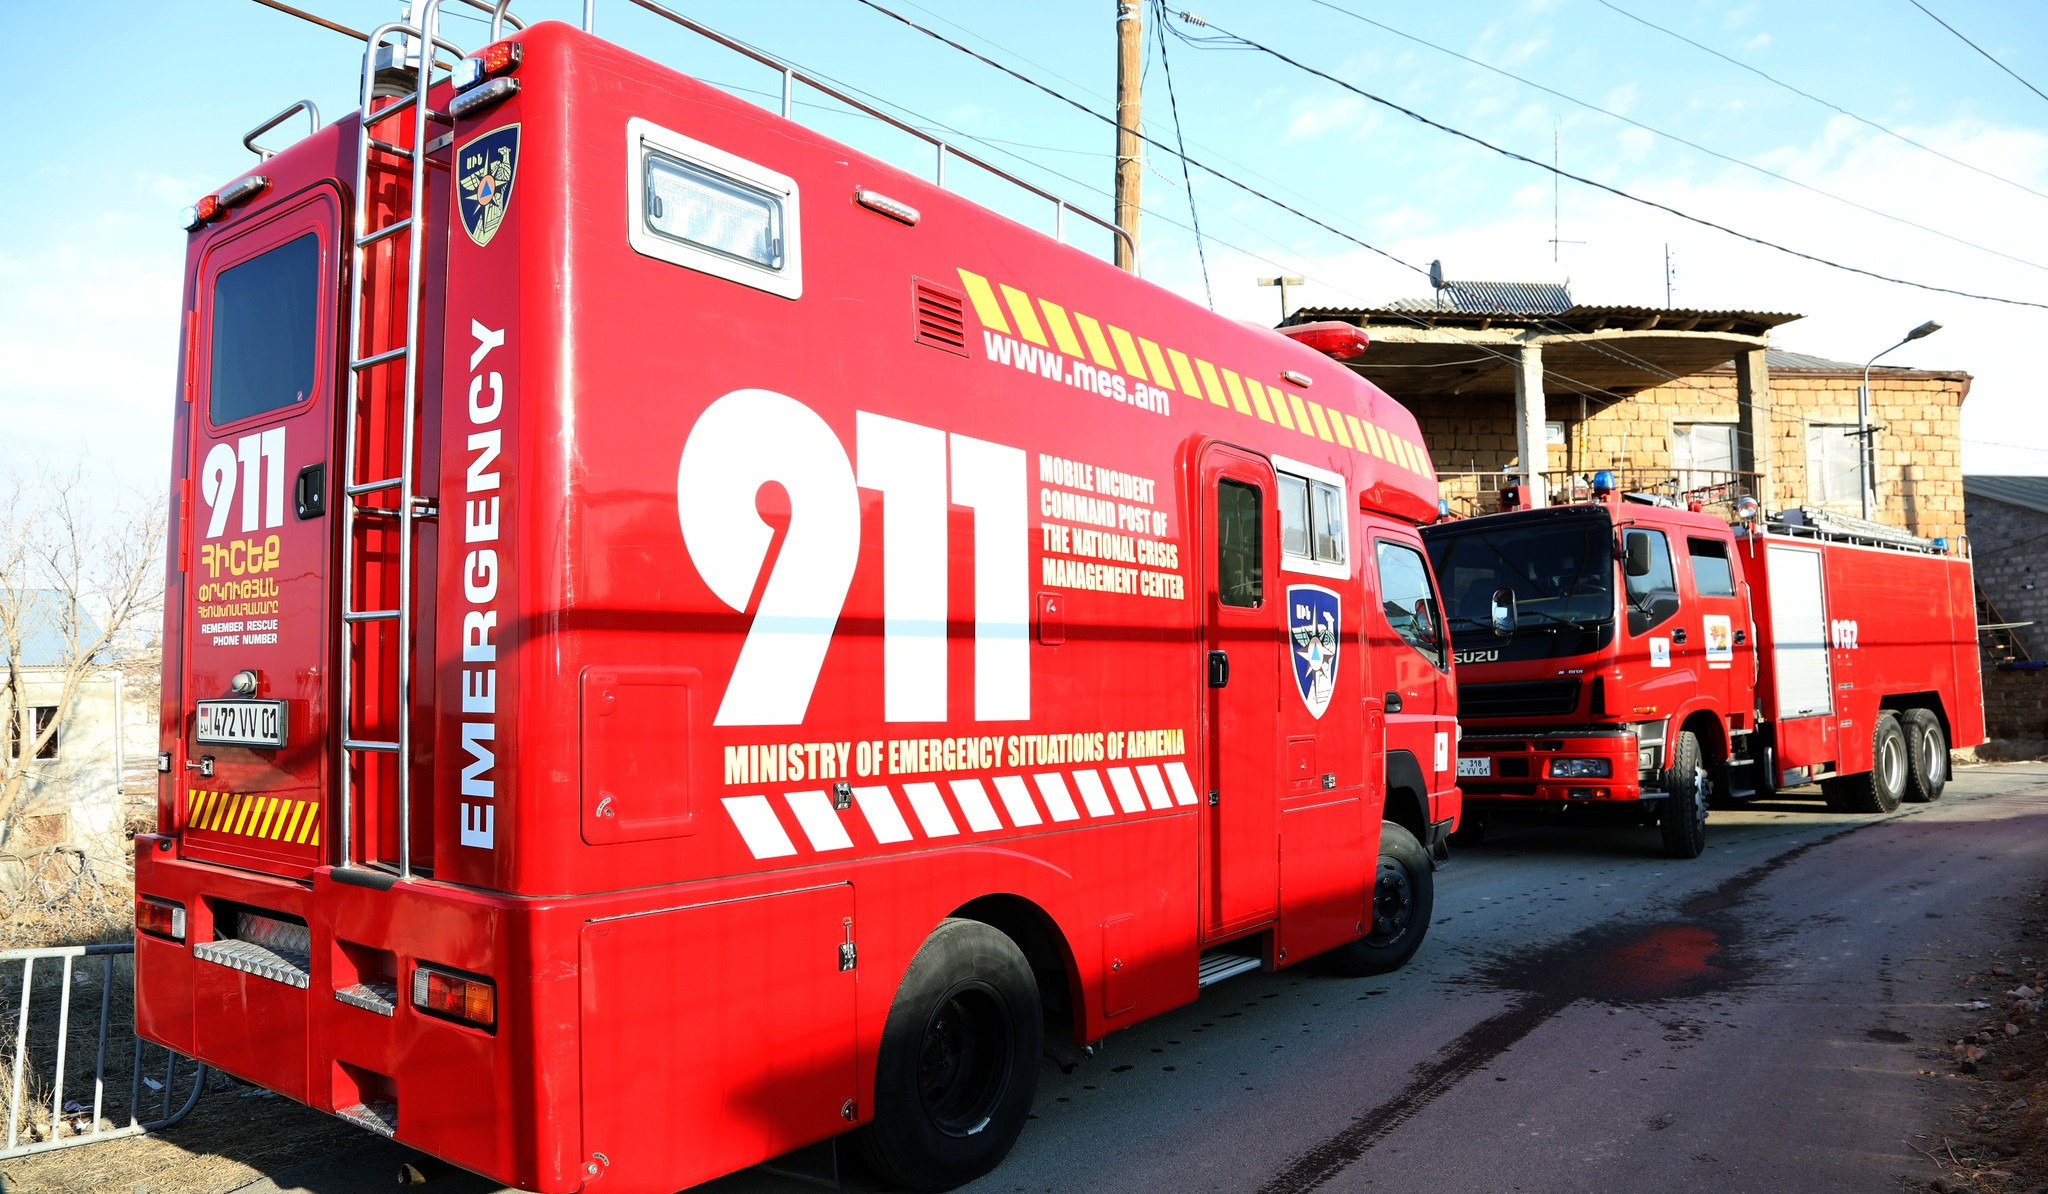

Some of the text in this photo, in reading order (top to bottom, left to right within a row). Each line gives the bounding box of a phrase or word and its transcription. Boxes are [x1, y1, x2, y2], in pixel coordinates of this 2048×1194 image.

[983, 330, 1170, 417] www.mes.am
[201, 426, 286, 539] 911
[1039, 453, 1155, 505] MOBILE INCIDENT
[1040, 488, 1168, 537] COMMAND POST OF
[676, 388, 1031, 727] 911
[1041, 522, 1178, 570] THE NATIONAL CRISIS
[460, 318, 506, 850] EMERGENCY
[1042, 557, 1185, 600] MANAGEMENT CENTER
[201, 619, 278, 634] REMEMBER RESCUE
[213, 633, 277, 646] PHONE NUMBER
[1453, 649, 1499, 664] SUZU
[214, 707, 235, 737] 472
[239, 707, 258, 738] VV
[262, 708, 278, 738] 01
[724, 728, 1185, 785] MINISTRY OF EMERGENCY SITUATIONS OF ARMENIA
[1469, 759, 1482, 767] 318
[1479, 767, 1488, 775] 01
